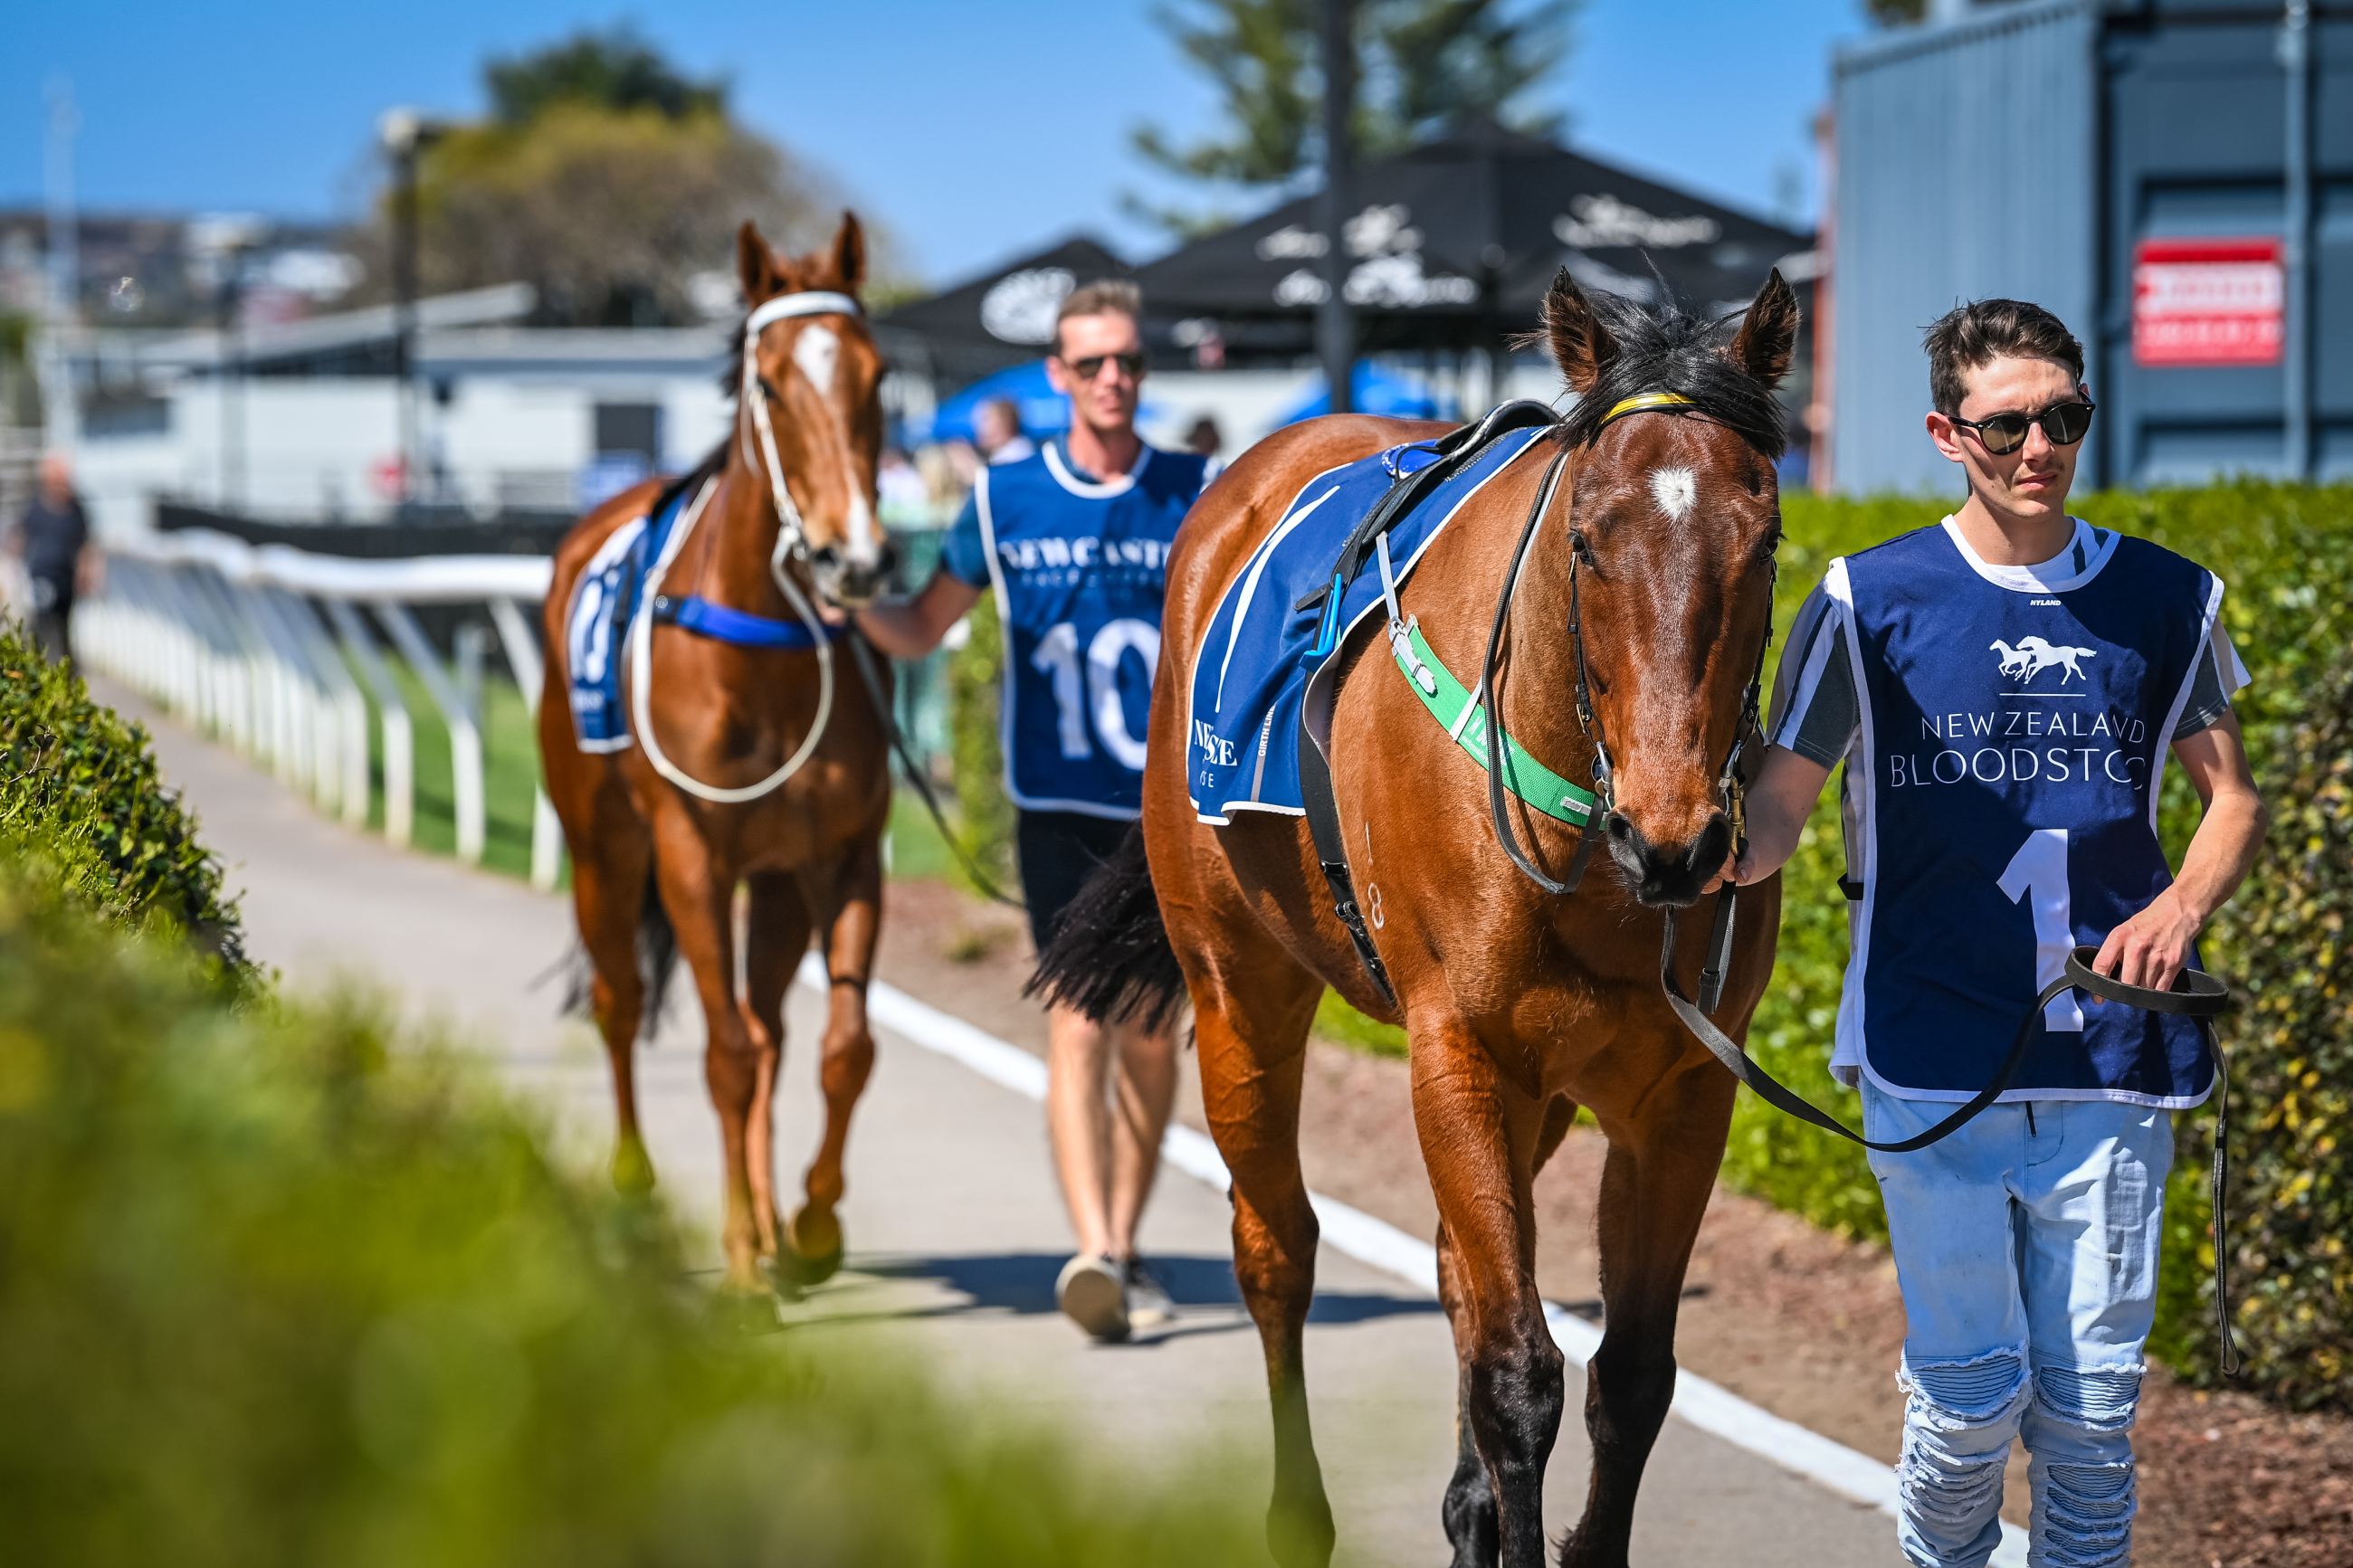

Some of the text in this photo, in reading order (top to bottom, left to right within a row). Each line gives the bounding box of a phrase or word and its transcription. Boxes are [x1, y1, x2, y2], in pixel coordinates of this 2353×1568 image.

[1030, 618, 1162, 771] 10
[1921, 711, 2146, 744] NEW ZEALAND
[1258, 727, 1270, 757] GIRTH
[1996, 828, 2083, 1032] 1
